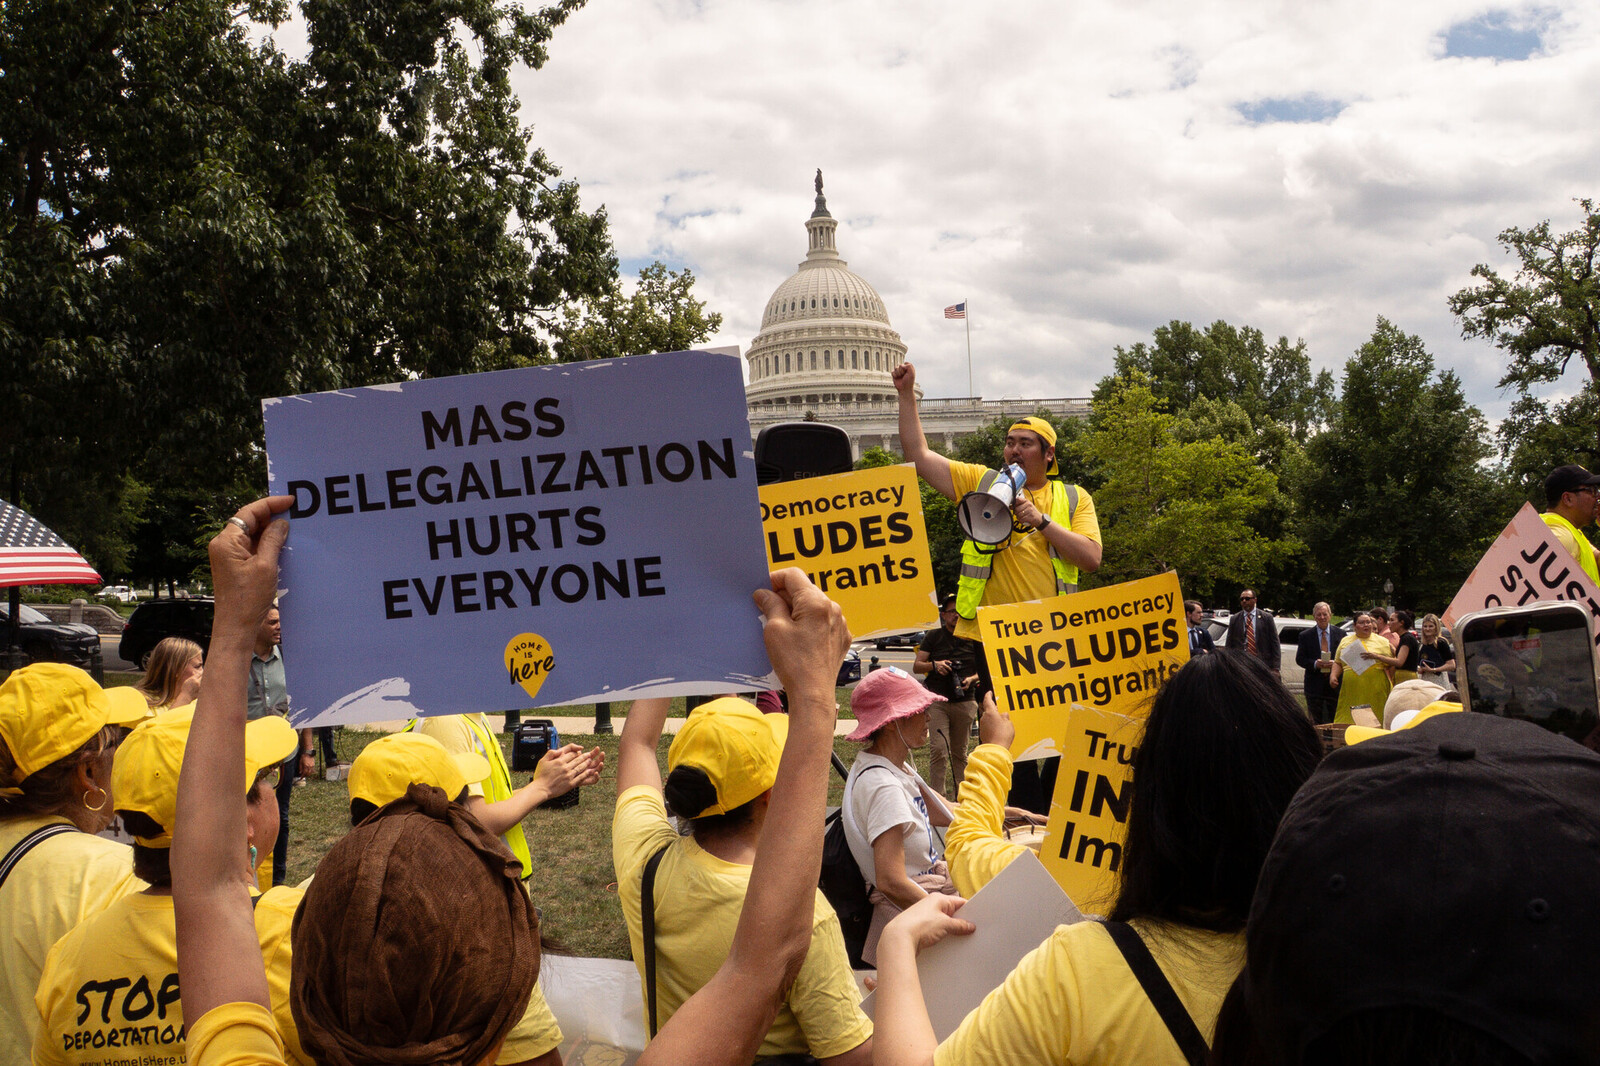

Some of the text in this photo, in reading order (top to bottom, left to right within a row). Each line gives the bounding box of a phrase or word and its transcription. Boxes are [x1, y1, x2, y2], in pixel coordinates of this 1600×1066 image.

[422, 398, 566, 450] MASS
[287, 438, 738, 520] DELEGALIZATION
[427, 507, 606, 560] HURTS
[767, 512, 914, 563] LUDES
[383, 556, 666, 620] EVERYONE
[808, 554, 919, 592] rants
[990, 592, 1175, 639] True Democracy
[510, 656, 556, 685] here
[513, 642, 542, 653] HOME
[997, 618, 1180, 678] INCLUDES
[1005, 659, 1180, 712] Immigrants
[1085, 729, 1138, 765] Tru
[76, 973, 181, 1026] STOP
